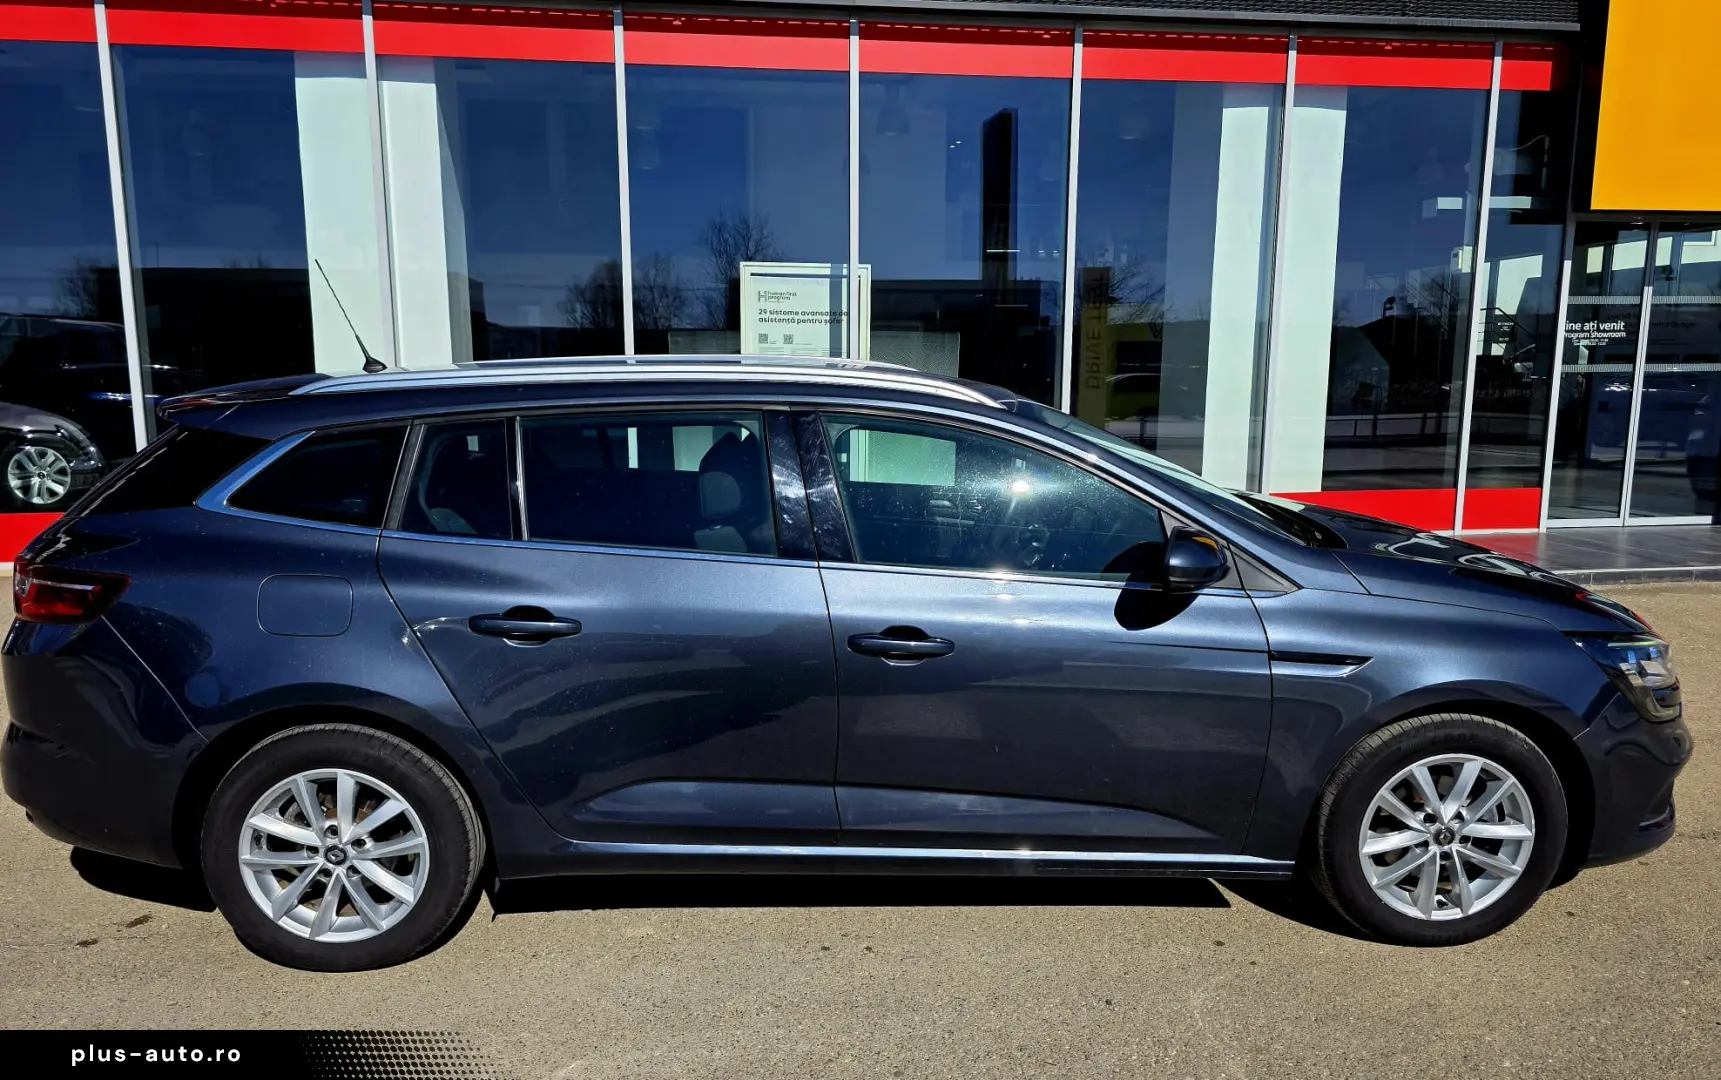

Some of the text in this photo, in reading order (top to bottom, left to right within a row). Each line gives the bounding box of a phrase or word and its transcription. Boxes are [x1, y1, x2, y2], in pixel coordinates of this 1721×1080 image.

[800, 309, 838, 317] avansate
[797, 317, 824, 326] pentru
[1565, 320, 1582, 330] ine
[1583, 320, 1598, 333] ați
[1599, 320, 1626, 330] venit
